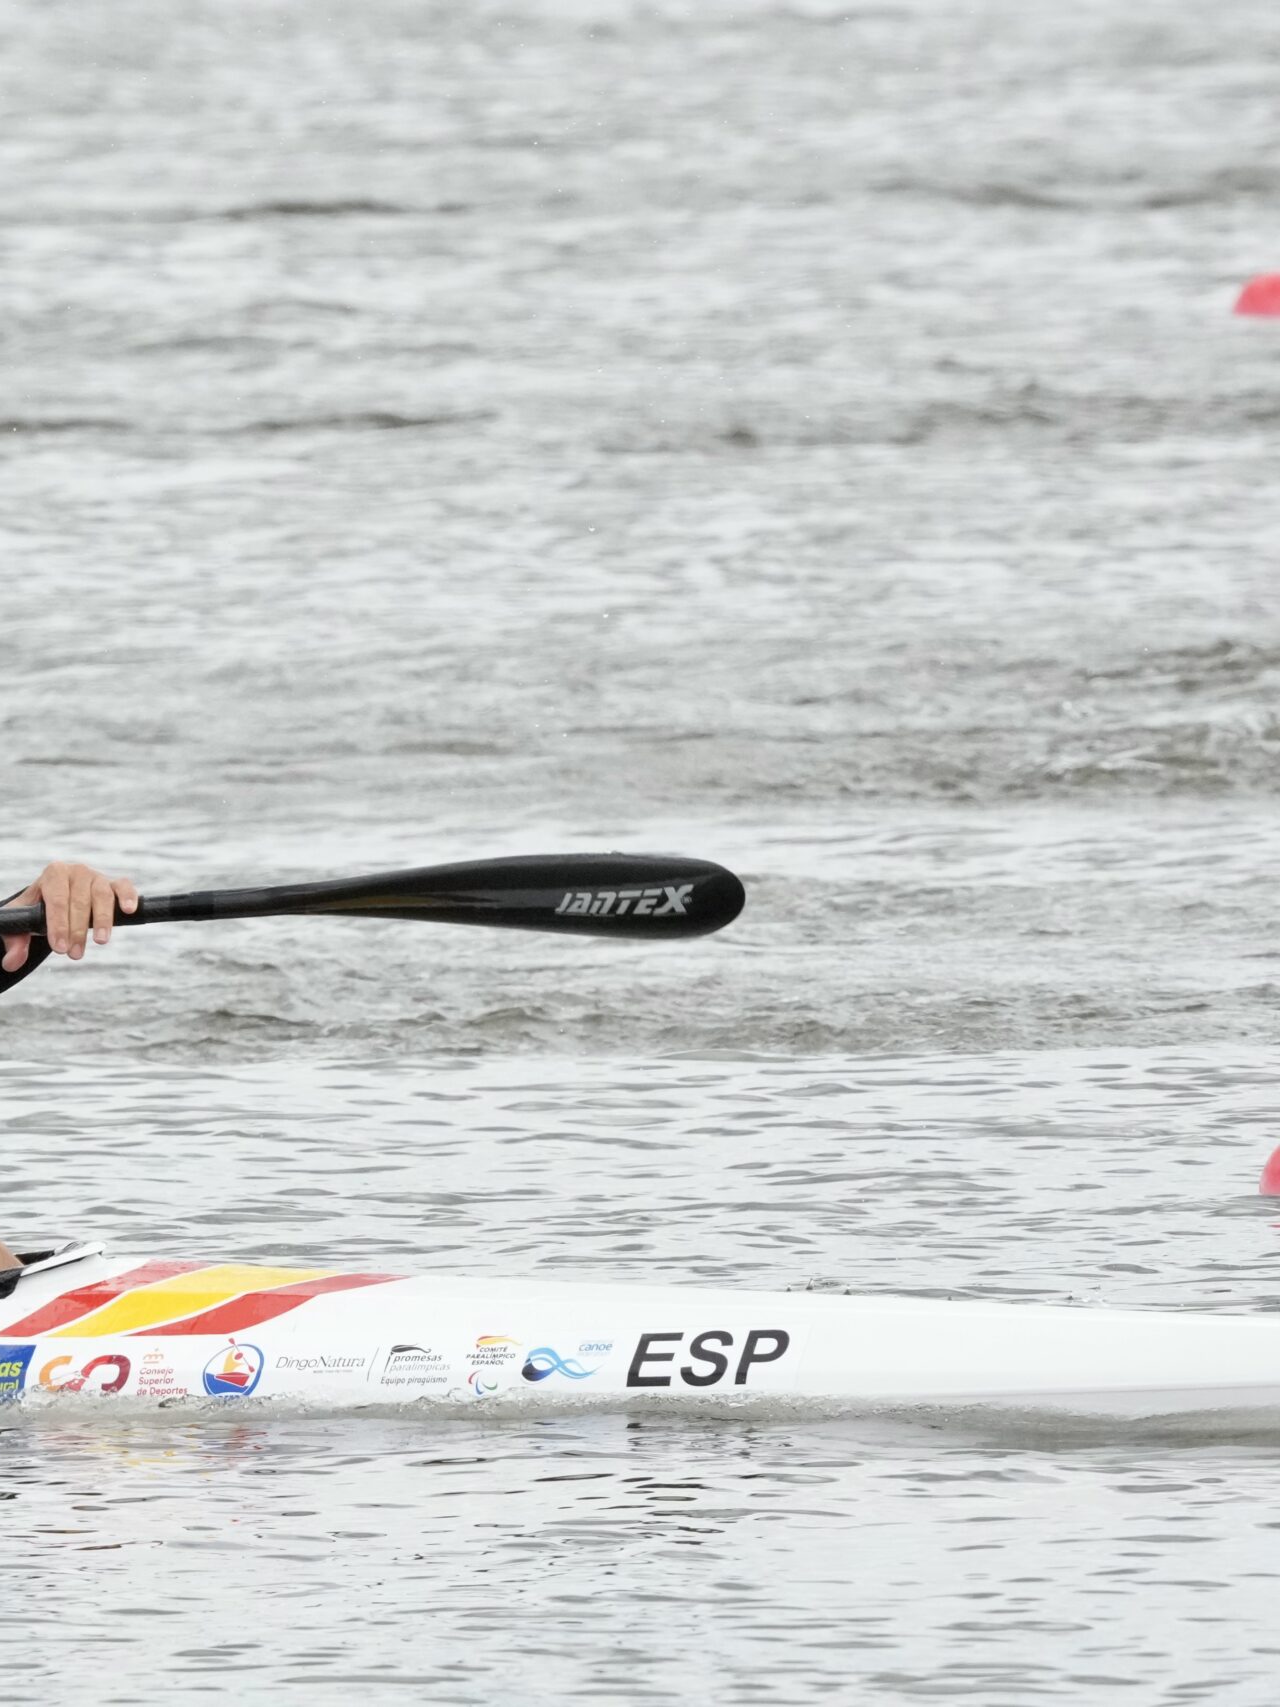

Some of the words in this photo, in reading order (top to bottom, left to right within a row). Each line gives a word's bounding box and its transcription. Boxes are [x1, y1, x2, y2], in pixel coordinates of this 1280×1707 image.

[578, 1343, 613, 1352] canoe
[275, 1356, 366, 1371] DingoNatura
[392, 1354, 443, 1364] promesas
[625, 1329, 790, 1388] ESP
[139, 1367, 175, 1378] Consejo
[138, 1377, 175, 1386] Superior
[380, 1376, 406, 1387] Equipo
[136, 1387, 148, 1396] de
[150, 1387, 188, 1396] Deportes
